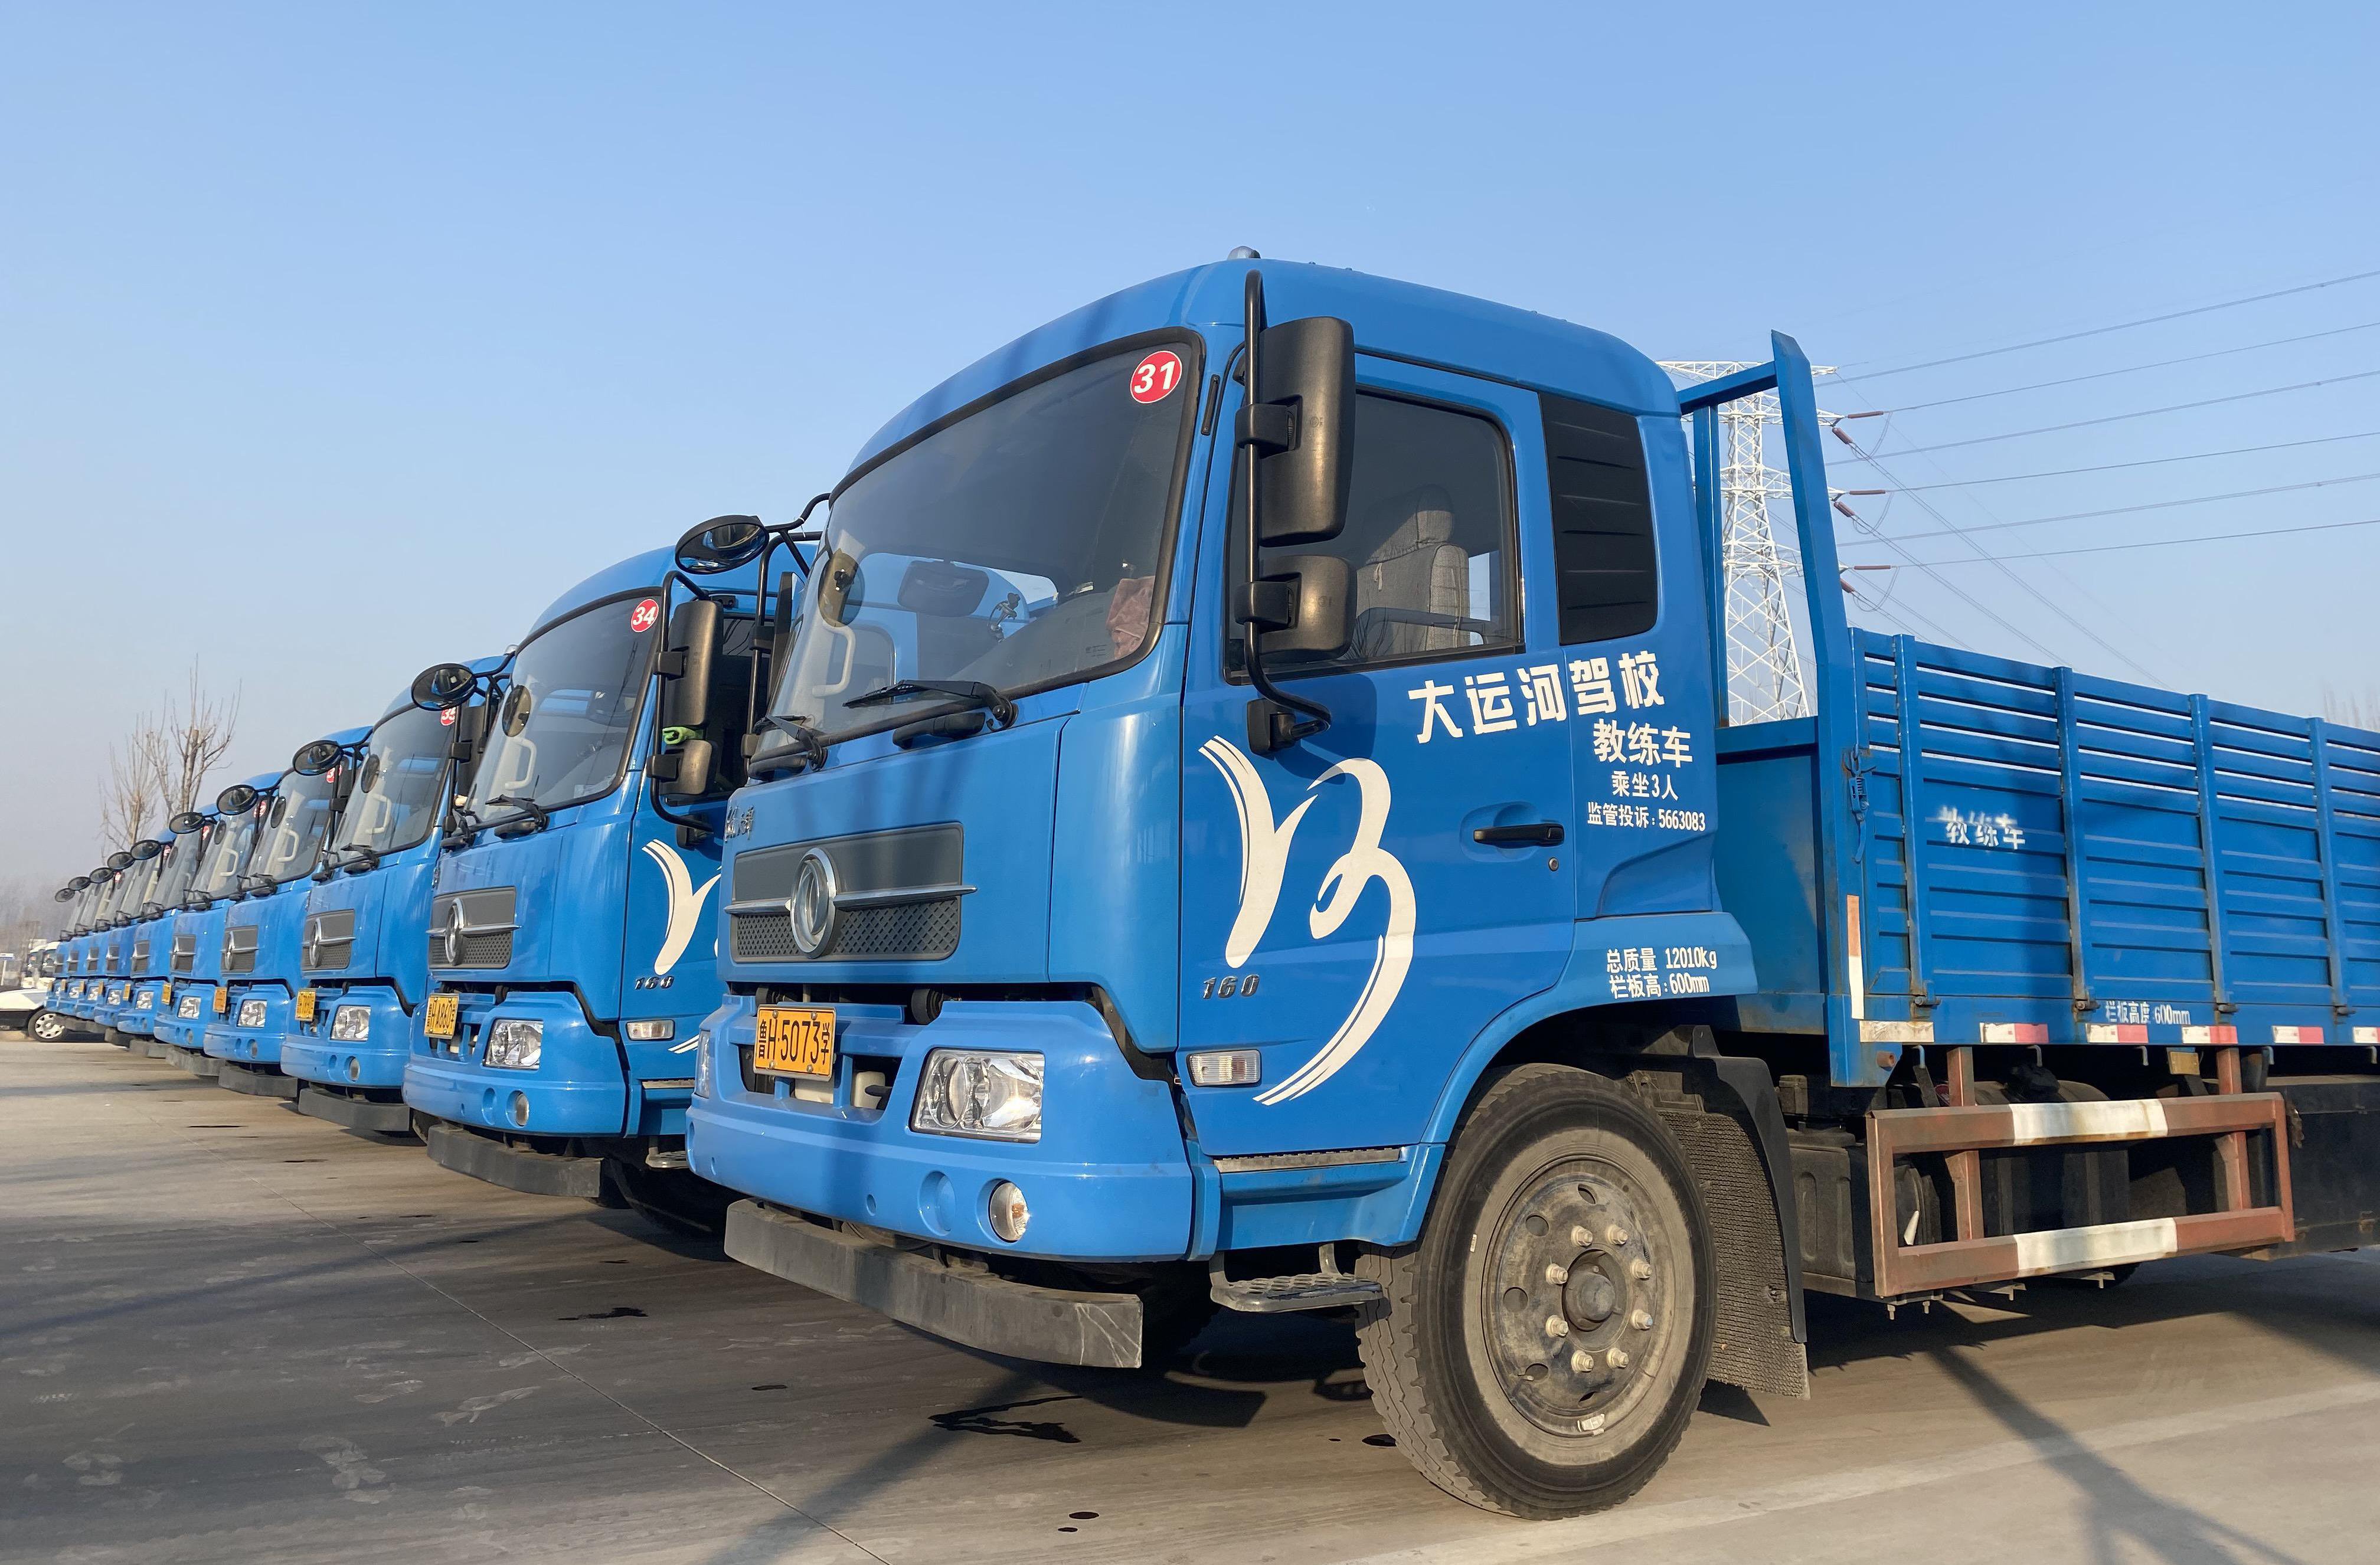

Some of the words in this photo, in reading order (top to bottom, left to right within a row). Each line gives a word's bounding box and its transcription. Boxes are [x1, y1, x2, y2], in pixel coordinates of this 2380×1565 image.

[1134, 361, 1175, 394] 31
[632, 606, 657, 626] 34
[1408, 650, 1665, 744] 大运河驾校
[1594, 719, 1693, 768] 教练车
[1611, 770, 1678, 801] 乘坐3人
[1607, 948, 1658, 973] 总质量
[635, 976, 674, 990] 160
[1203, 974, 1260, 999] 160
